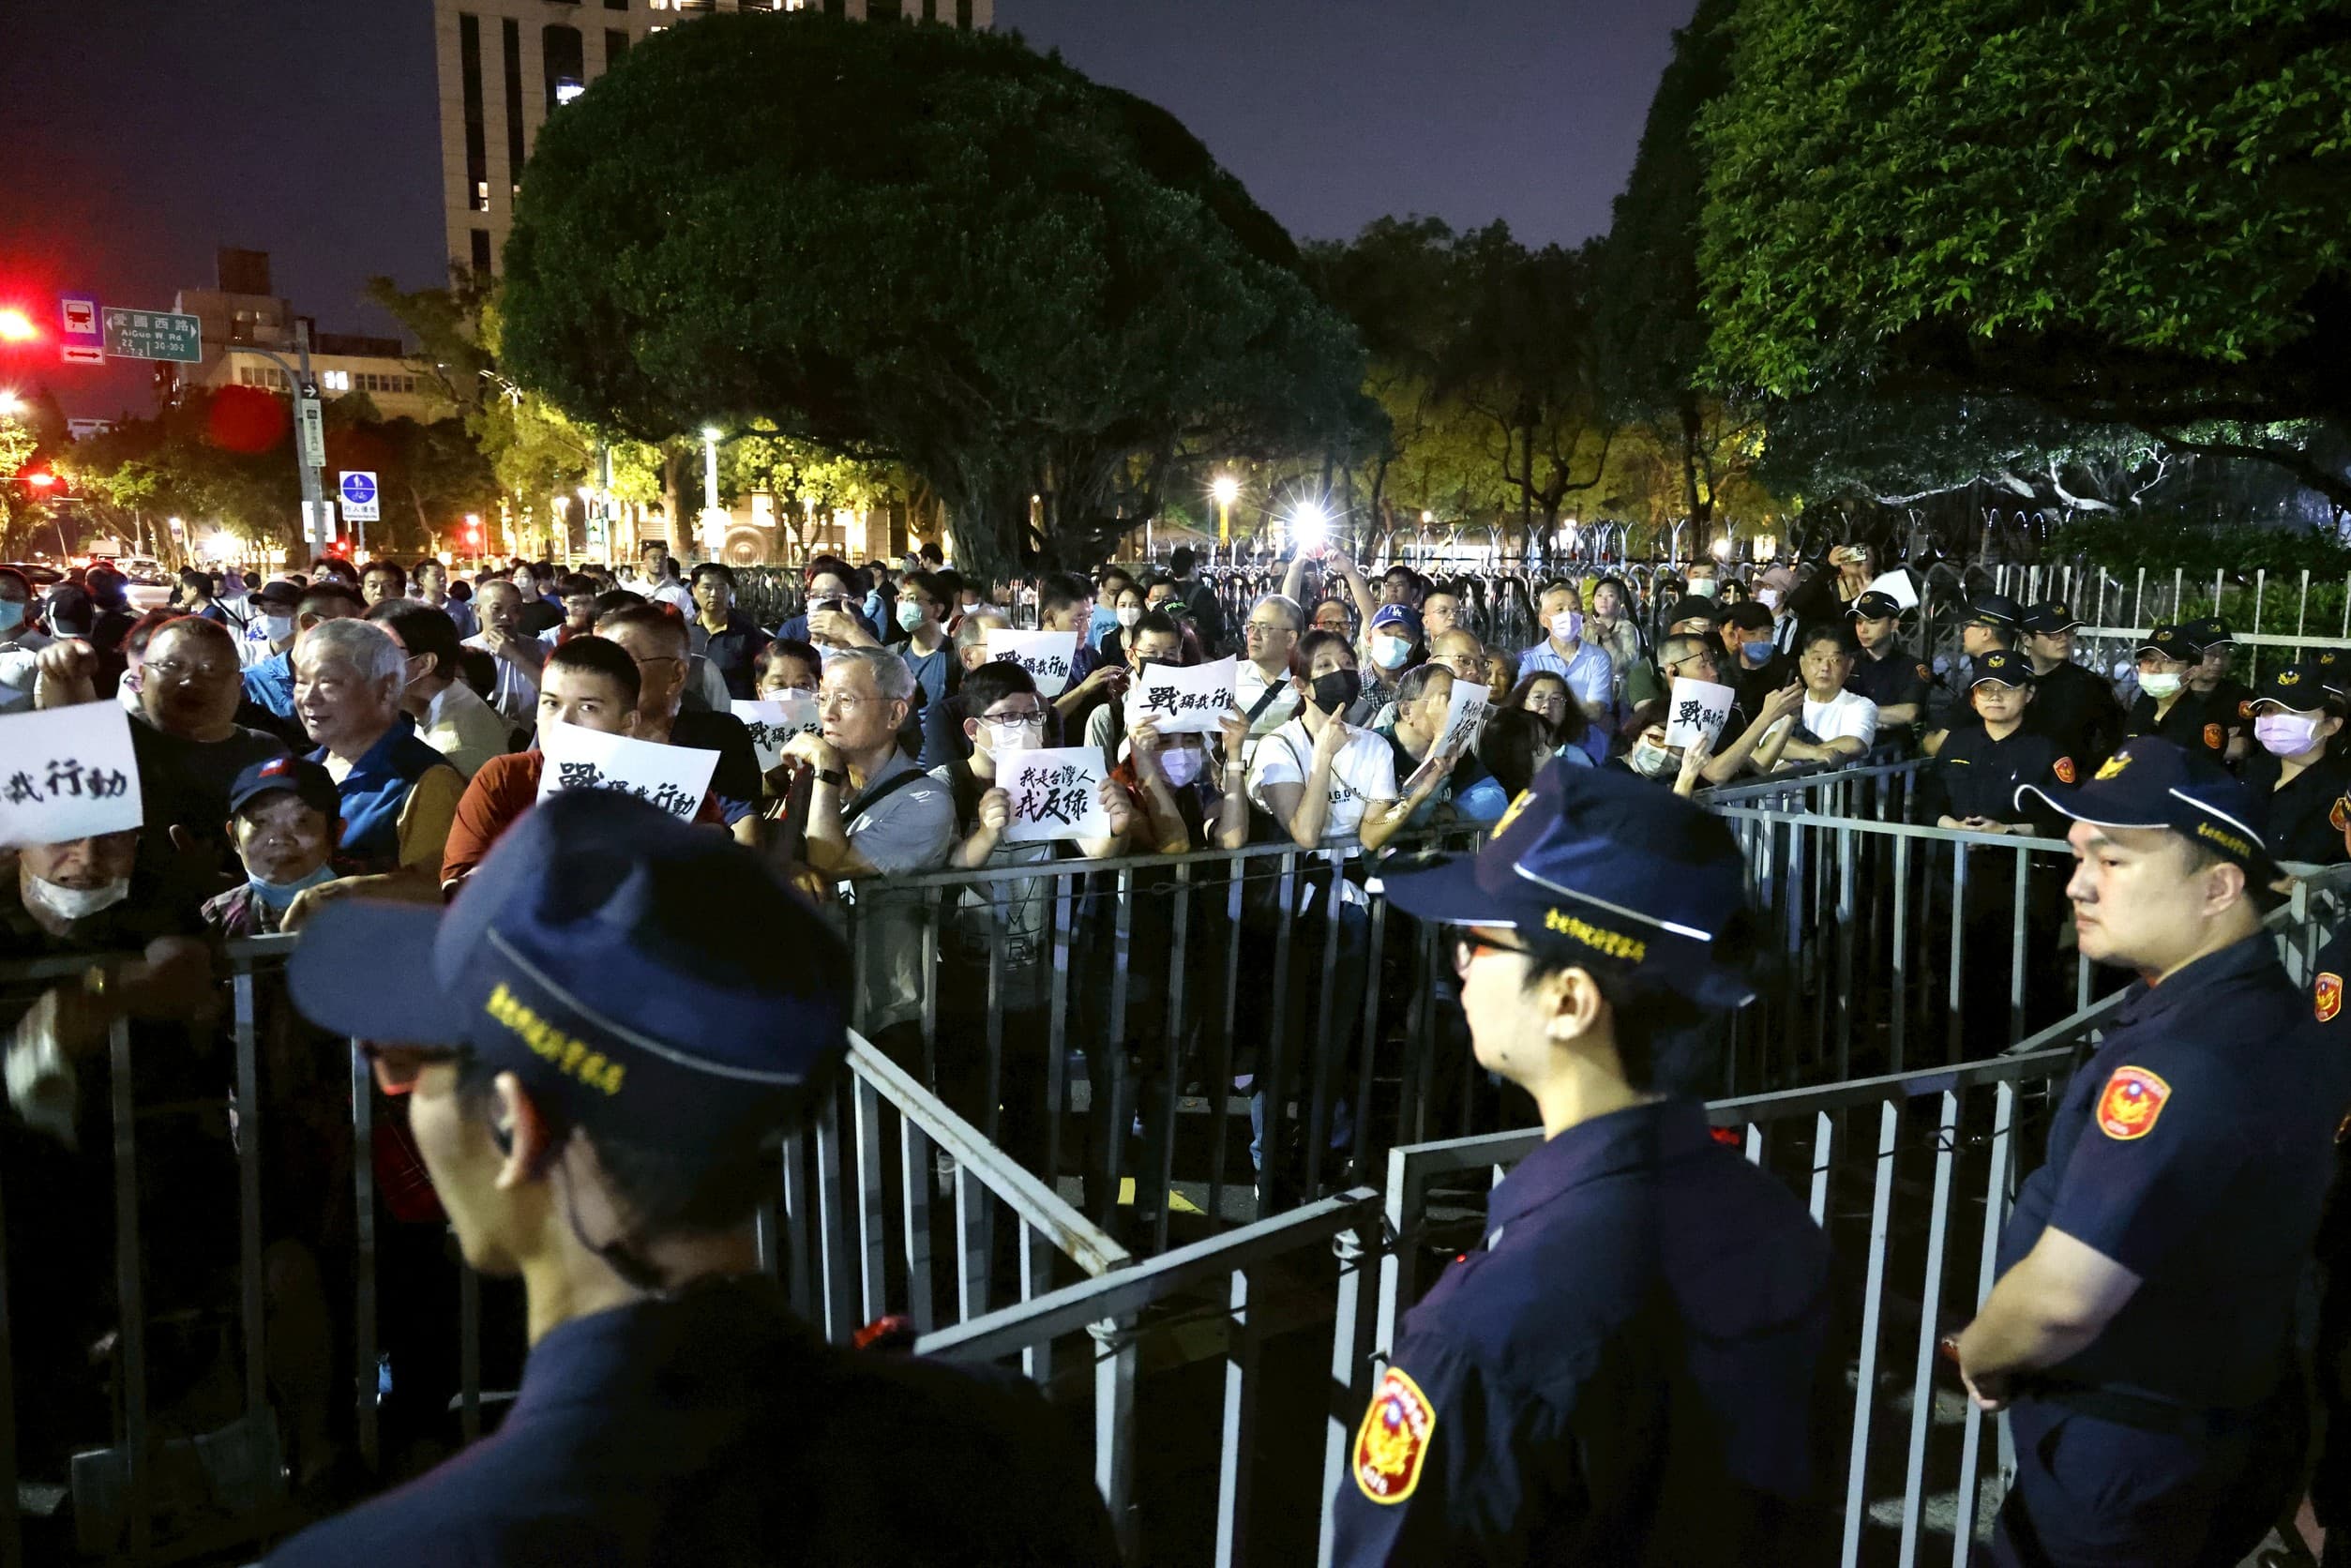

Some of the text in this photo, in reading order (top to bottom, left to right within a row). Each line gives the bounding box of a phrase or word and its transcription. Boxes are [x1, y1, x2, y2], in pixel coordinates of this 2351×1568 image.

[113, 313, 188, 332] 愛國西路
[1019, 765, 1095, 788] 我是台灣人
[1016, 788, 1088, 825] 我反綠
